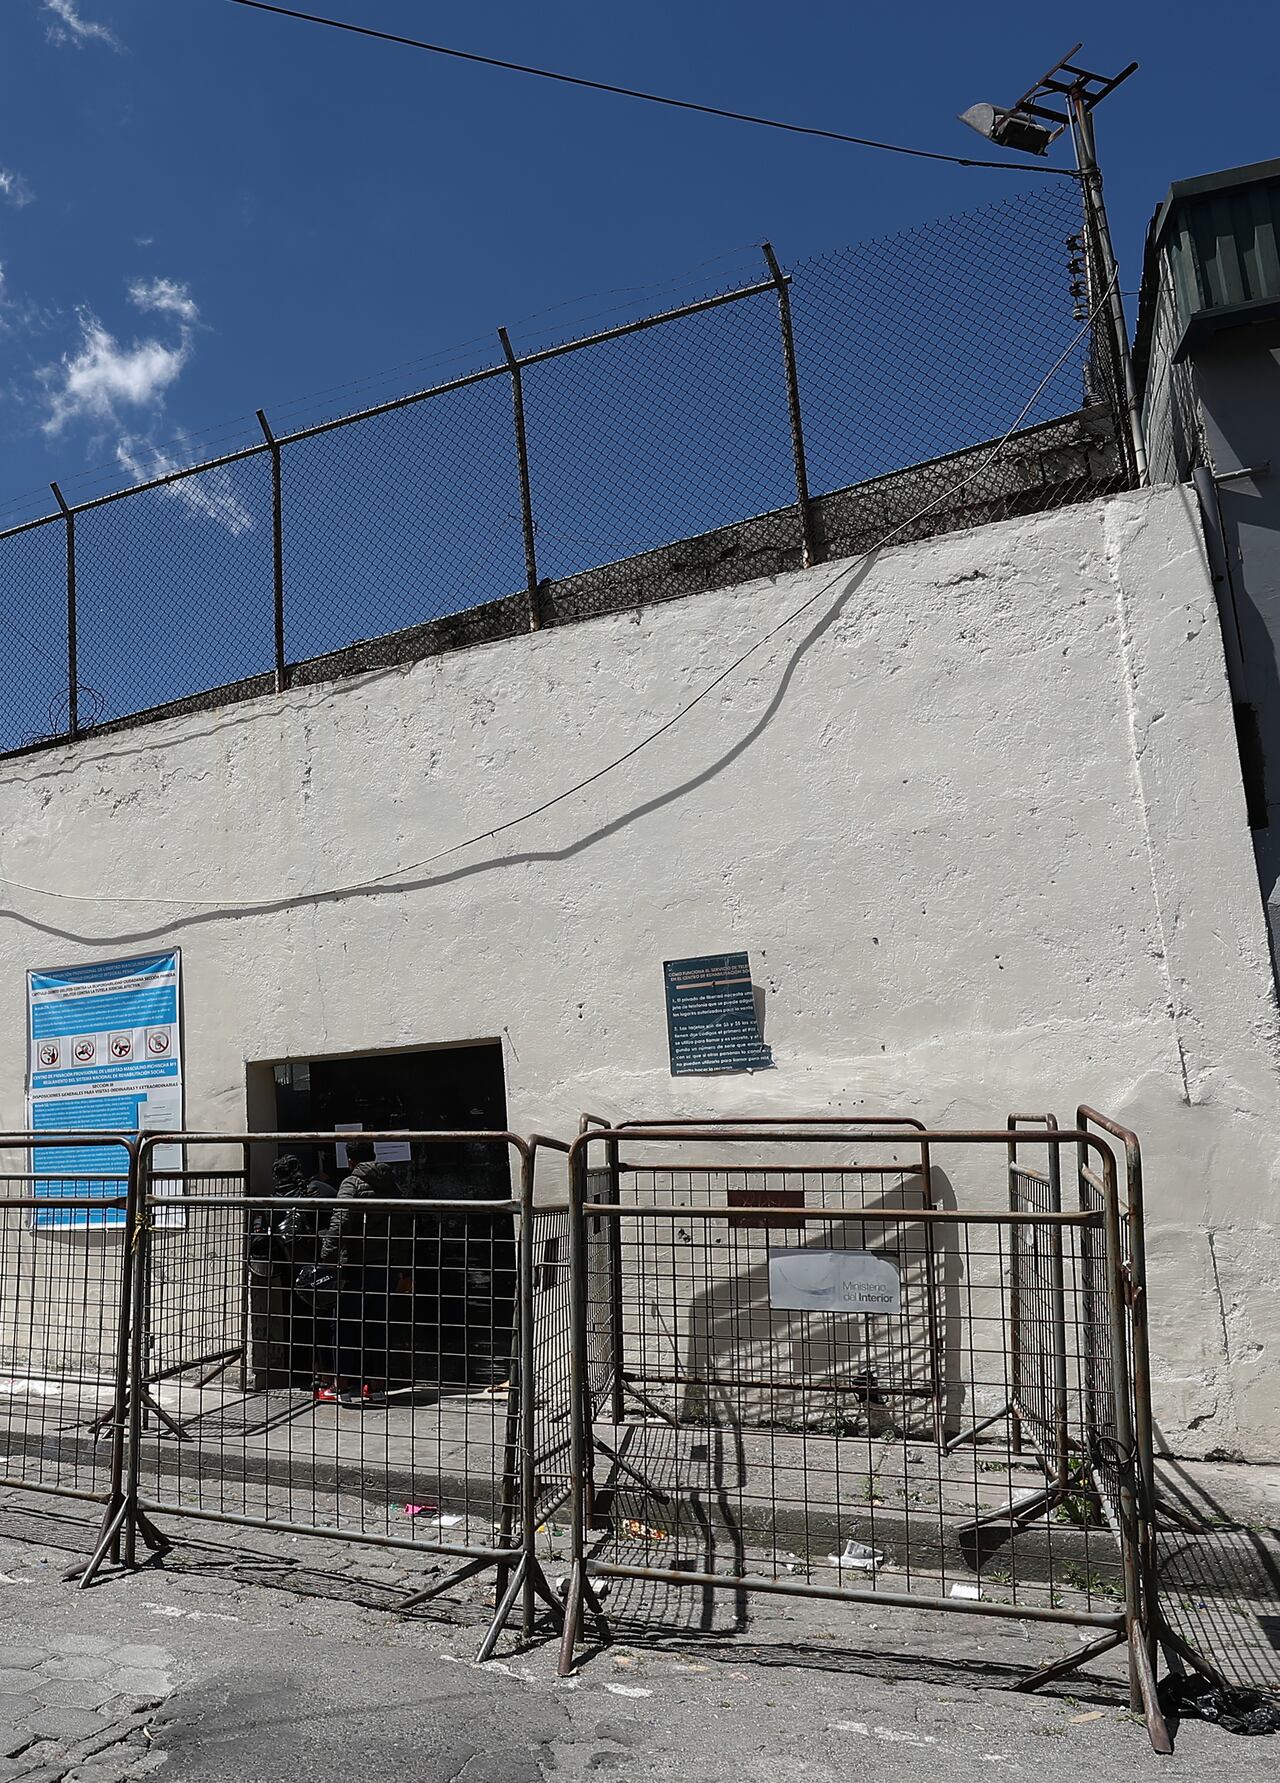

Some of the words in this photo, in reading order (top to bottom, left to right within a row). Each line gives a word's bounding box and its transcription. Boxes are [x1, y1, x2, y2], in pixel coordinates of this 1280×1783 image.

[842, 1281, 886, 1291] Ministerio
[843, 1292, 856, 1301] del
[859, 1293, 894, 1303] Interior
